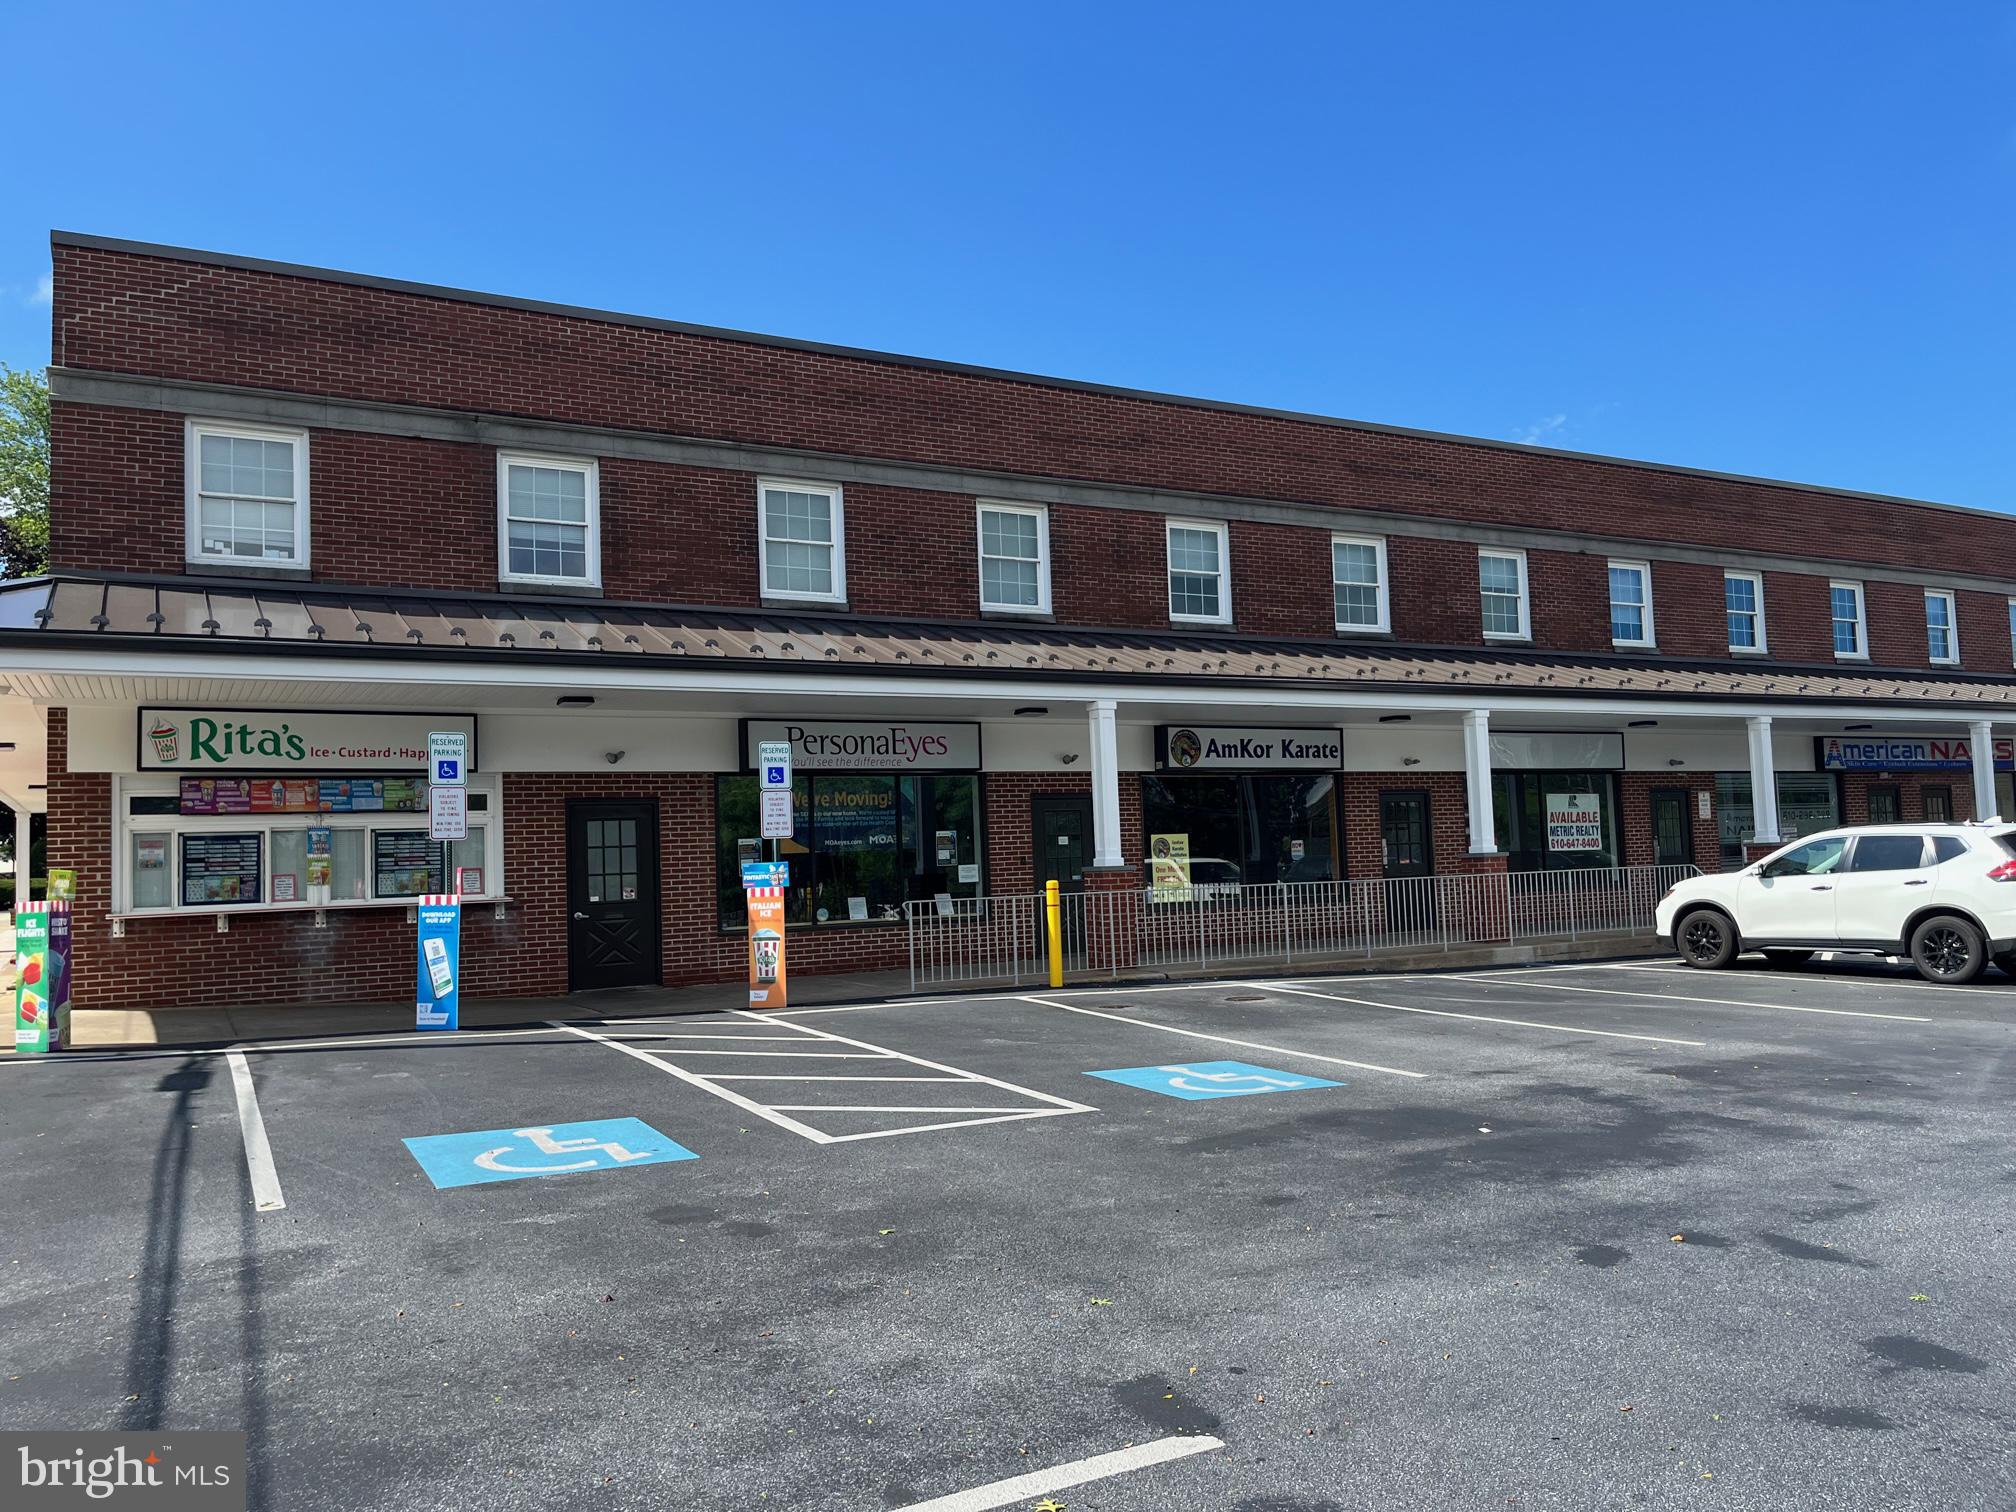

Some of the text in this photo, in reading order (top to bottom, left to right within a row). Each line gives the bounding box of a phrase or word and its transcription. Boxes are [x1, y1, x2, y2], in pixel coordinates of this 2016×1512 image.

[190, 717, 306, 763] Rita's
[431, 738, 464, 746] RESERVED
[784, 726, 948, 762] PersonaEyes
[310, 746, 330, 758] Ice
[338, 746, 391, 759] Custard
[433, 749, 462, 757] PARKING
[1204, 737, 1274, 759] AmKor
[1281, 738, 1339, 759] Karate
[1825, 739, 1926, 767] American
[816, 758, 834, 767] see
[835, 757, 852, 767] the
[853, 757, 903, 768] difference
[834, 790, 893, 809] Moving!
[1549, 811, 1599, 824] AVAILABLE
[1550, 825, 1600, 837] METRIC REALTY
[824, 839, 863, 847] MOAeyes.com
[1550, 838, 1600, 849] 610-647-8400
[750, 902, 782, 910] ITALIAN
[759, 909, 772, 918] ICE
[25, 918, 37, 928] ICE
[17, 928, 46, 938] FLIGHTS
